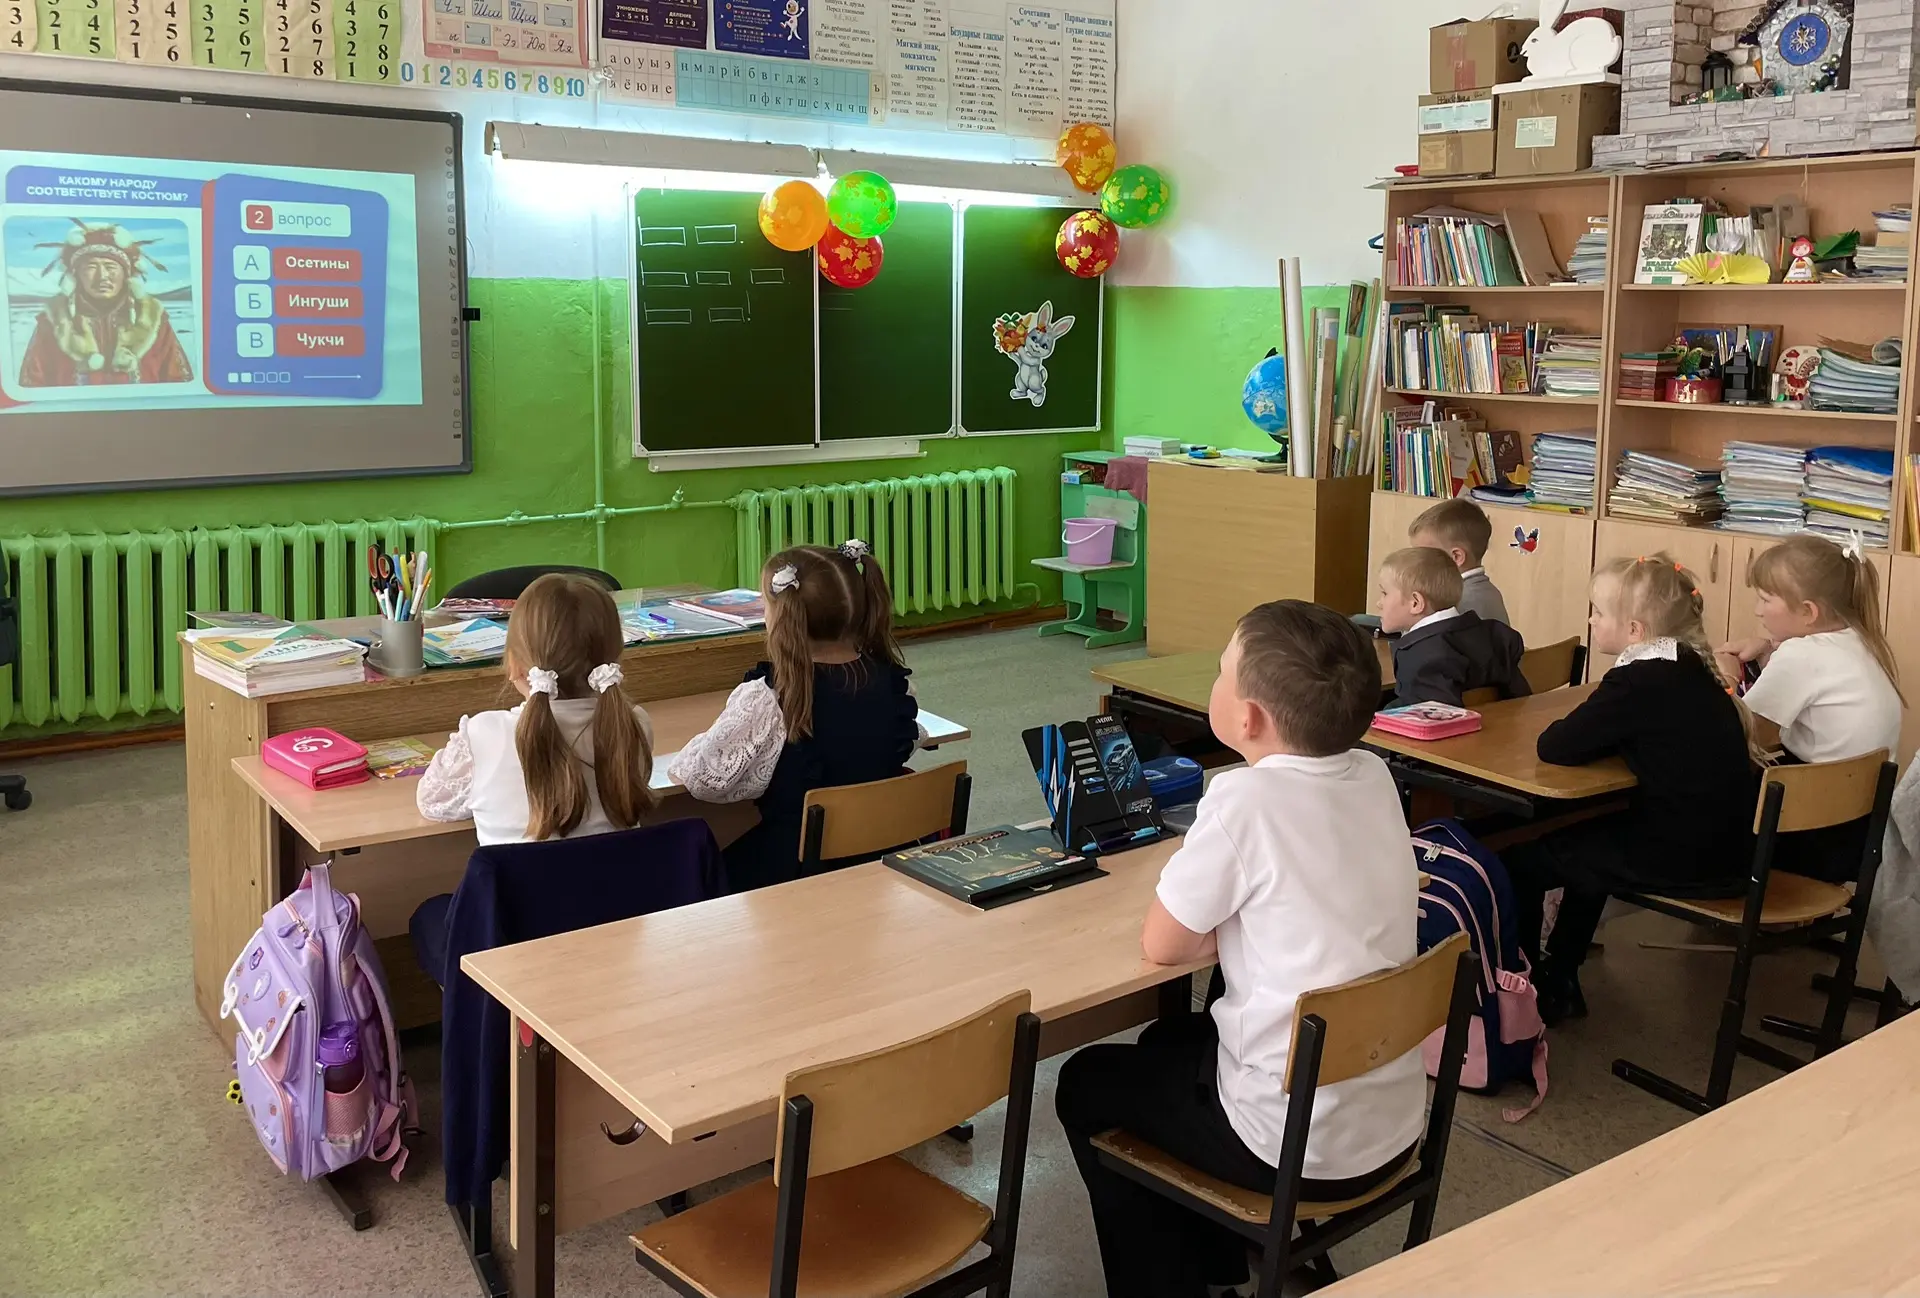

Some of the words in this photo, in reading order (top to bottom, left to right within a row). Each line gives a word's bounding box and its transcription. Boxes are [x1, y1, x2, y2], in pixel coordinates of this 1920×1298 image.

[9, 7, 22, 25] 3
[165, 1, 177, 18] 4
[202, 4, 214, 21] 3
[238, 8, 250, 25] 5
[345, 0, 356, 16] 4
[377, 4, 389, 20] 6
[48, 10, 61, 28] 2
[87, 14, 100, 31] 4
[130, 19, 141, 36] 2
[166, 23, 178, 40] 5
[277, 15, 289, 32] 3
[311, 18, 323, 35] 6
[346, 20, 357, 37] 3
[378, 24, 389, 41] 7
[10, 30, 24, 47] 4
[52, 33, 61, 51] 1
[89, 37, 101, 54] 5
[203, 26, 215, 43] 2
[239, 30, 251, 47] 6
[279, 36, 290, 53] 2
[312, 39, 323, 56] 7
[896, 39, 922, 49] Мягкий
[132, 42, 141, 59] 1
[167, 45, 179, 62] 6
[206, 48, 215, 65] 1
[240, 51, 251, 68] 7
[346, 41, 357, 57] 2
[378, 44, 389, 61] 8
[900, 53, 937, 61] показатель
[281, 57, 289, 74] 1
[313, 59, 324, 77] 8
[348, 62, 356, 78] 1
[378, 64, 389, 81] 9
[905, 64, 935, 72] мягкости
[401, 62, 414, 82] 0
[422, 64, 430, 84] 1
[440, 66, 451, 85] 2
[456, 67, 467, 87] 3
[472, 68, 483, 88] 4
[487, 69, 499, 89] 5
[504, 71, 516, 90] 6
[521, 73, 533, 92] 7
[538, 75, 549, 93] 8
[553, 76, 565, 95] 9
[567, 78, 585, 97] 10
[58, 175, 107, 187] КАКОМУ
[110, 178, 158, 190] НАРОДУ
[26, 186, 128, 199] СООТВЕТСТВУЕТ
[132, 190, 188, 202] КОСТЮМ?
[254, 210, 264, 224] 2
[278, 214, 332, 228] вопрос
[244, 254, 259, 271] А
[286, 256, 349, 270] Осетины
[248, 293, 261, 310] Б
[288, 294, 349, 310] Ингуши
[250, 332, 264, 348] В
[297, 333, 345, 349] Чукчи
